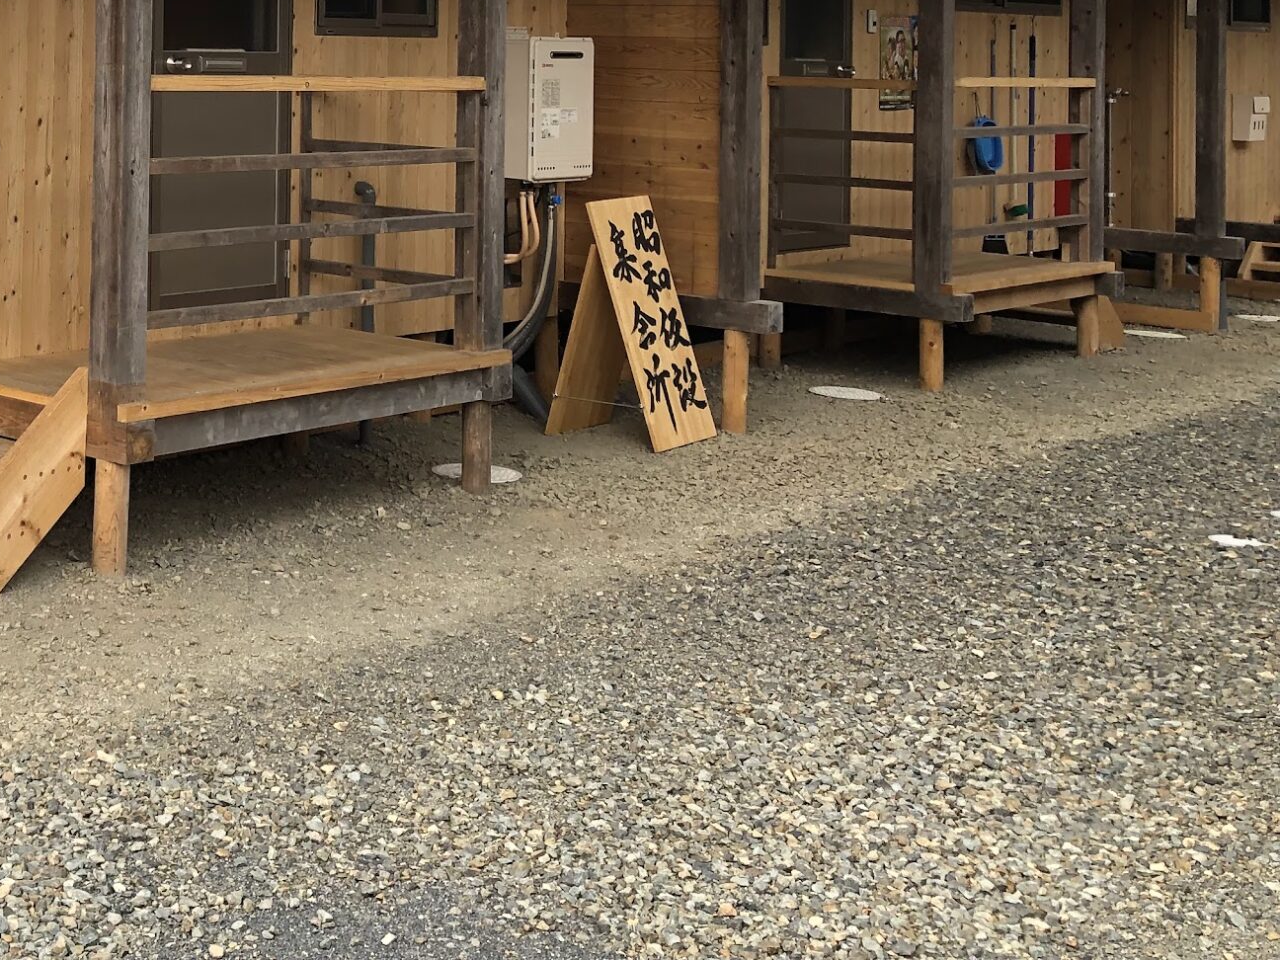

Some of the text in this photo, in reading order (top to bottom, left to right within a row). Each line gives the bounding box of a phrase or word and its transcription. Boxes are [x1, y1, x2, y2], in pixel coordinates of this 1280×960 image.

[607, 219, 679, 435] 集会所
[632, 209, 708, 413] 昭和仮設
